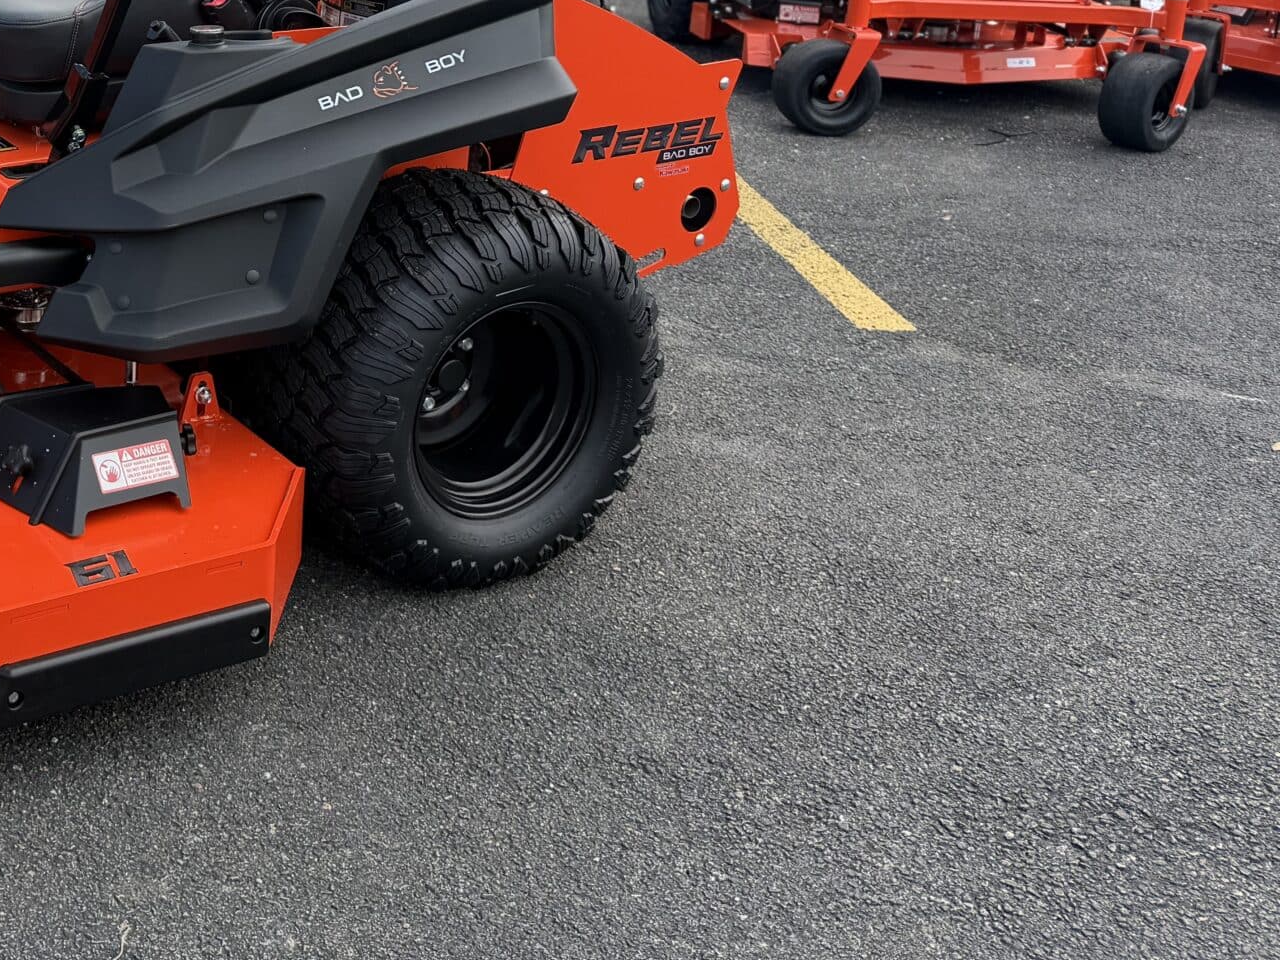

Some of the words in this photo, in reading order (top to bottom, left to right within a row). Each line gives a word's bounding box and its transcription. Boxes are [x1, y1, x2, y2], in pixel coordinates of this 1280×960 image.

[317, 85, 364, 111] BAD
[424, 49, 466, 74] BOY
[571, 116, 724, 164] REBEL
[662, 150, 686, 161] BAD
[688, 144, 712, 156] BOY
[132, 443, 168, 459] DANGER
[64, 549, 138, 588] 61
